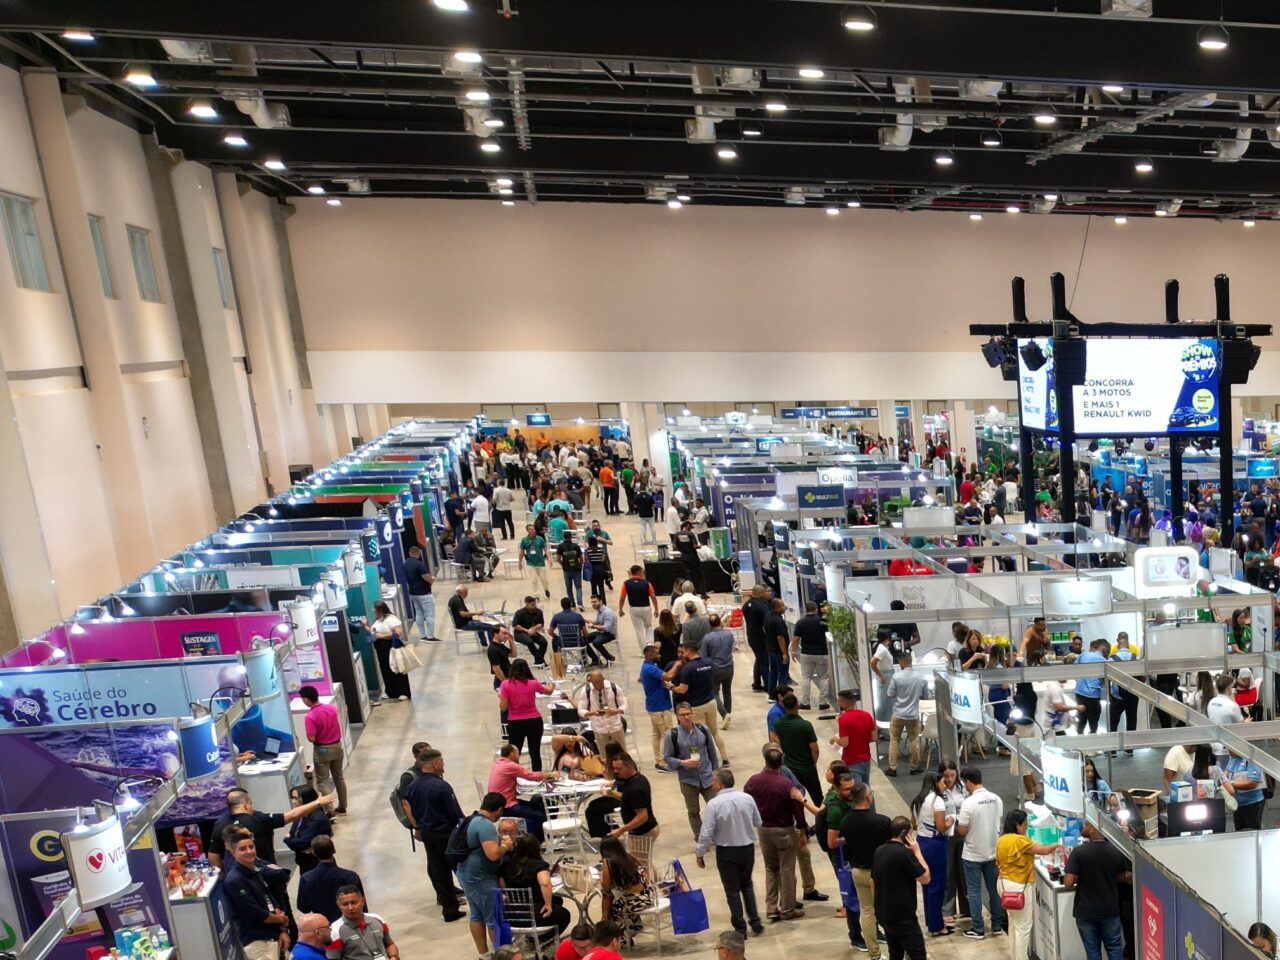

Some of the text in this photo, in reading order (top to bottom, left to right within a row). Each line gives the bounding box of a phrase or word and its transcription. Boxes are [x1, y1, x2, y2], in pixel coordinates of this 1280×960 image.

[1083, 379, 1134, 387] CONCORRA
[1084, 410, 1152, 418] RENAULT KWID
[184, 636, 217, 644] SUSTAGEN
[52, 686, 127, 704] Saúde do
[951, 694, 971, 708] RIA
[57, 698, 157, 722] Cérebro
